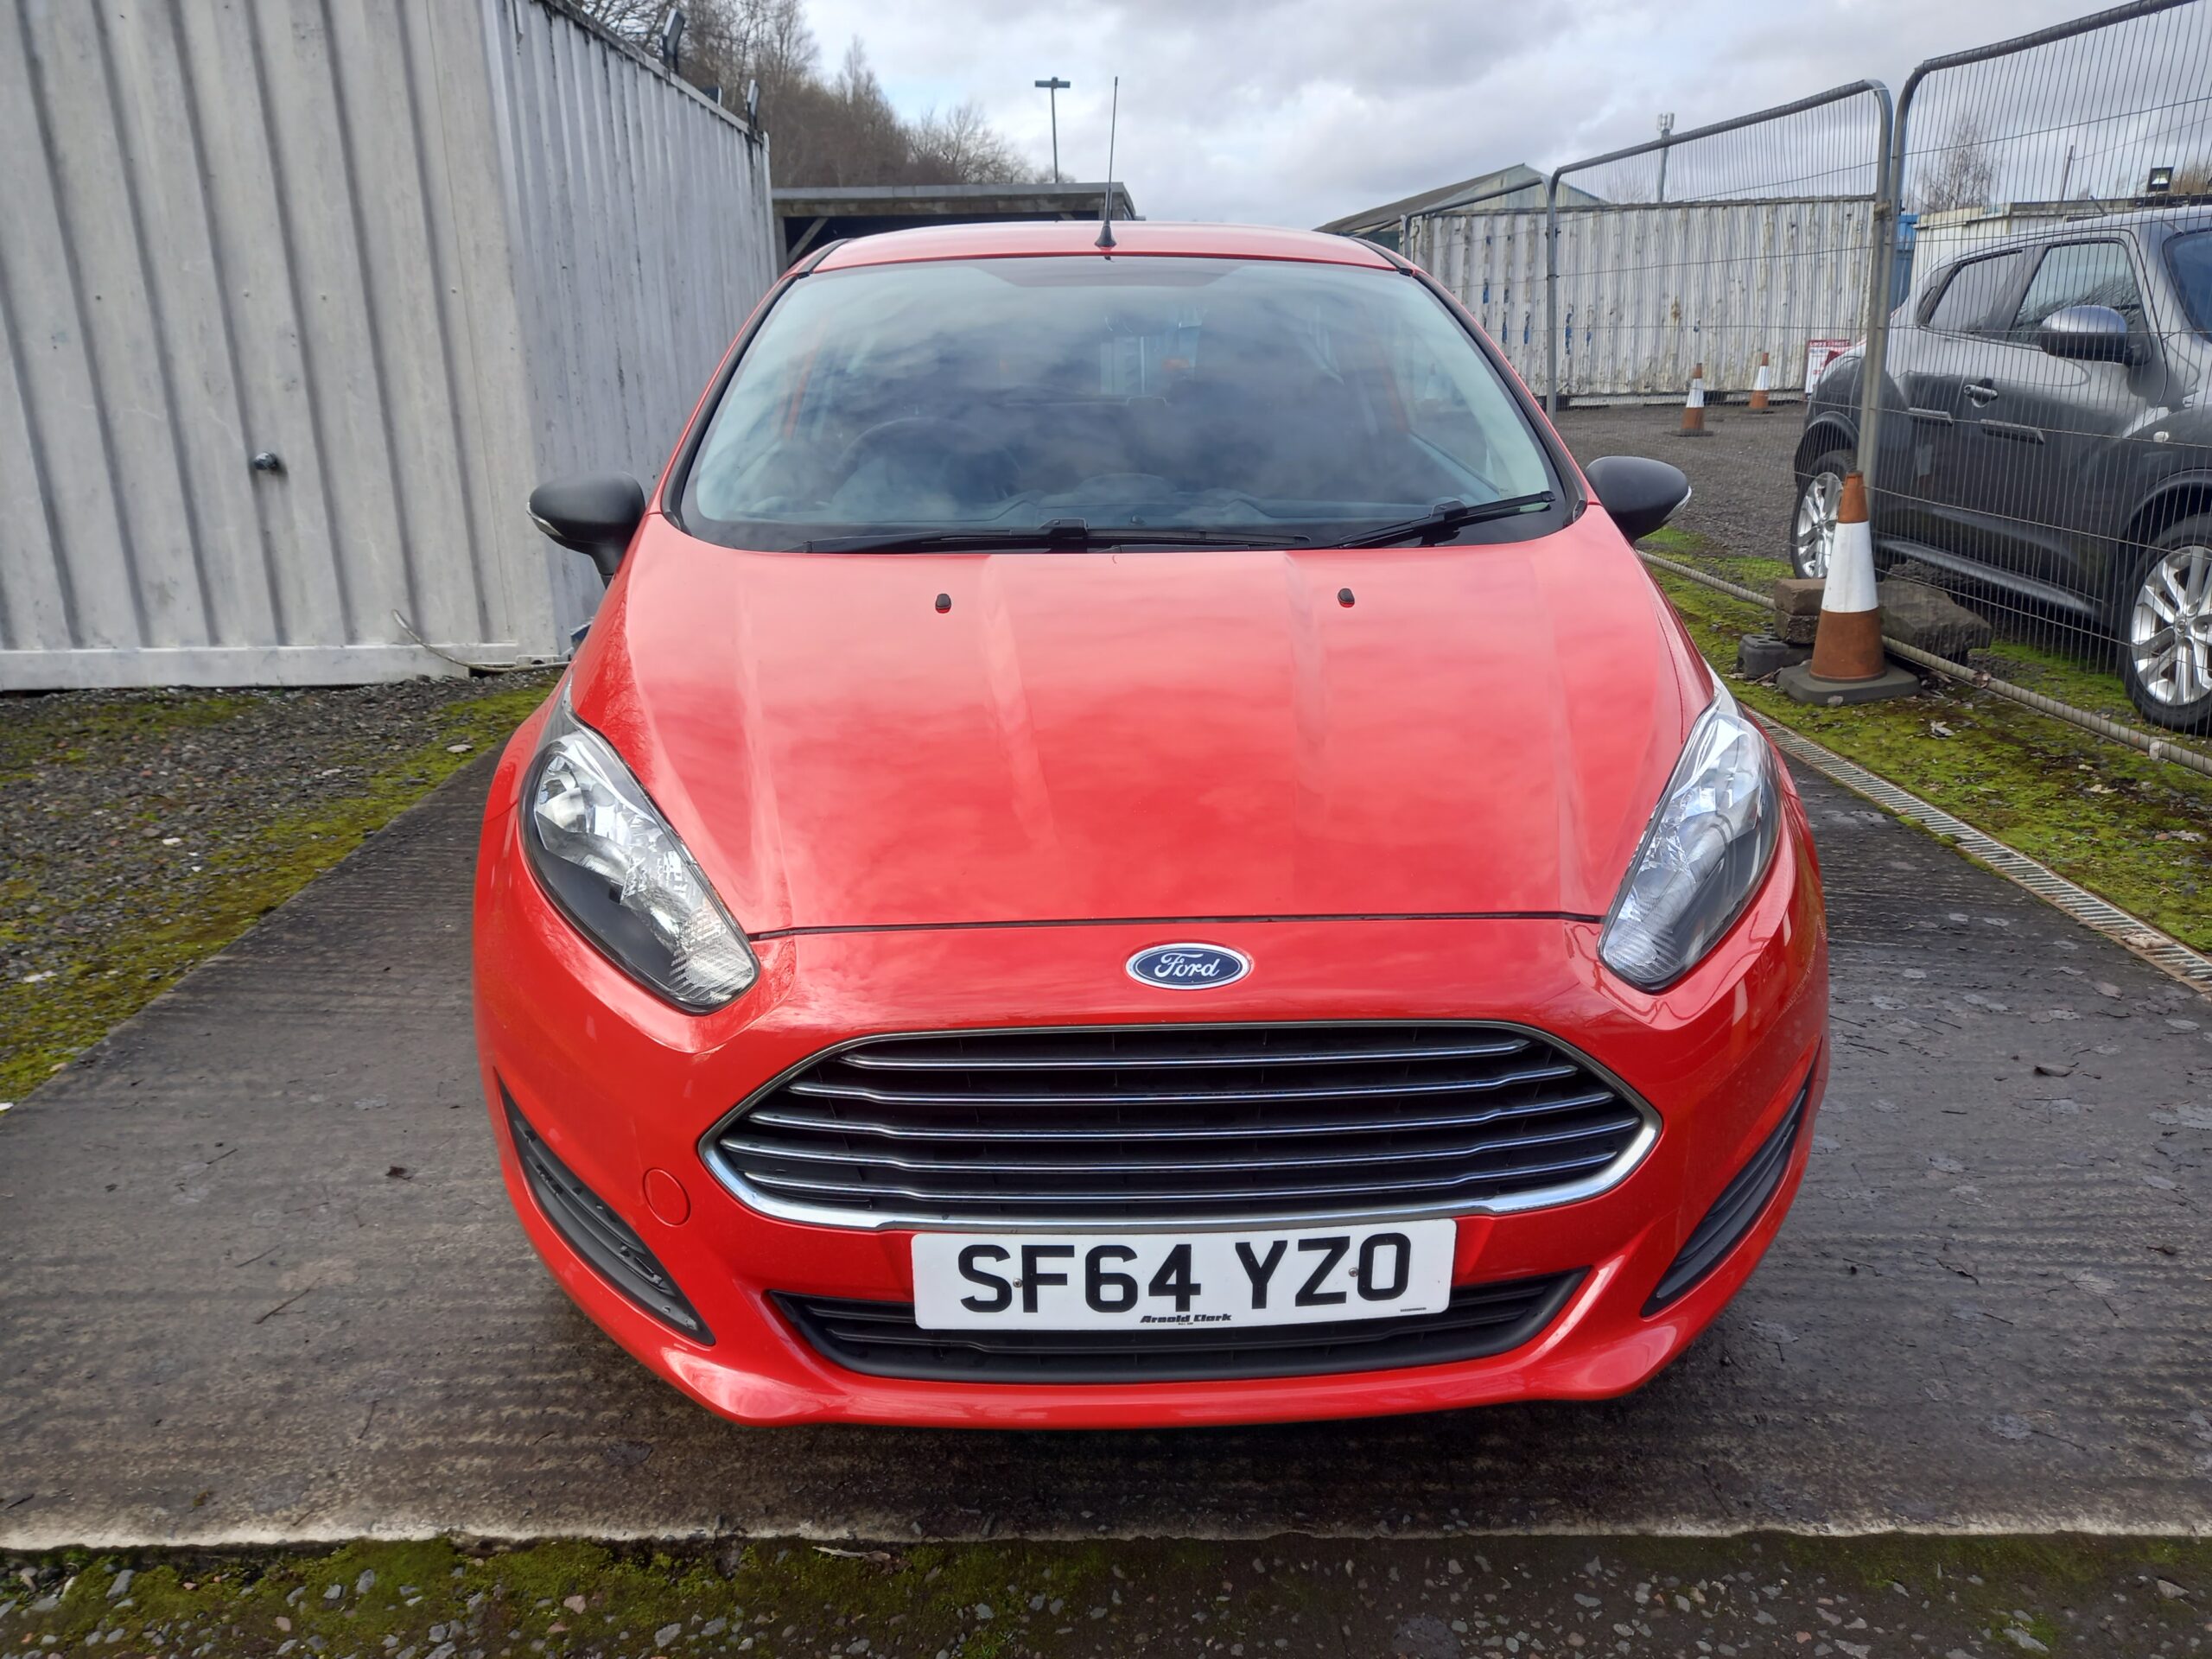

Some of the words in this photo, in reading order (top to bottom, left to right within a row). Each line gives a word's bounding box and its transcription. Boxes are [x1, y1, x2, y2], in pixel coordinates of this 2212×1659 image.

[1154, 952, 1220, 977] Ford
[958, 1243, 1201, 1313] SF64
[1235, 1232, 1411, 1309] YZO
[1140, 1314, 1191, 1324] Arnold
[1193, 1313, 1232, 1322] Clark
